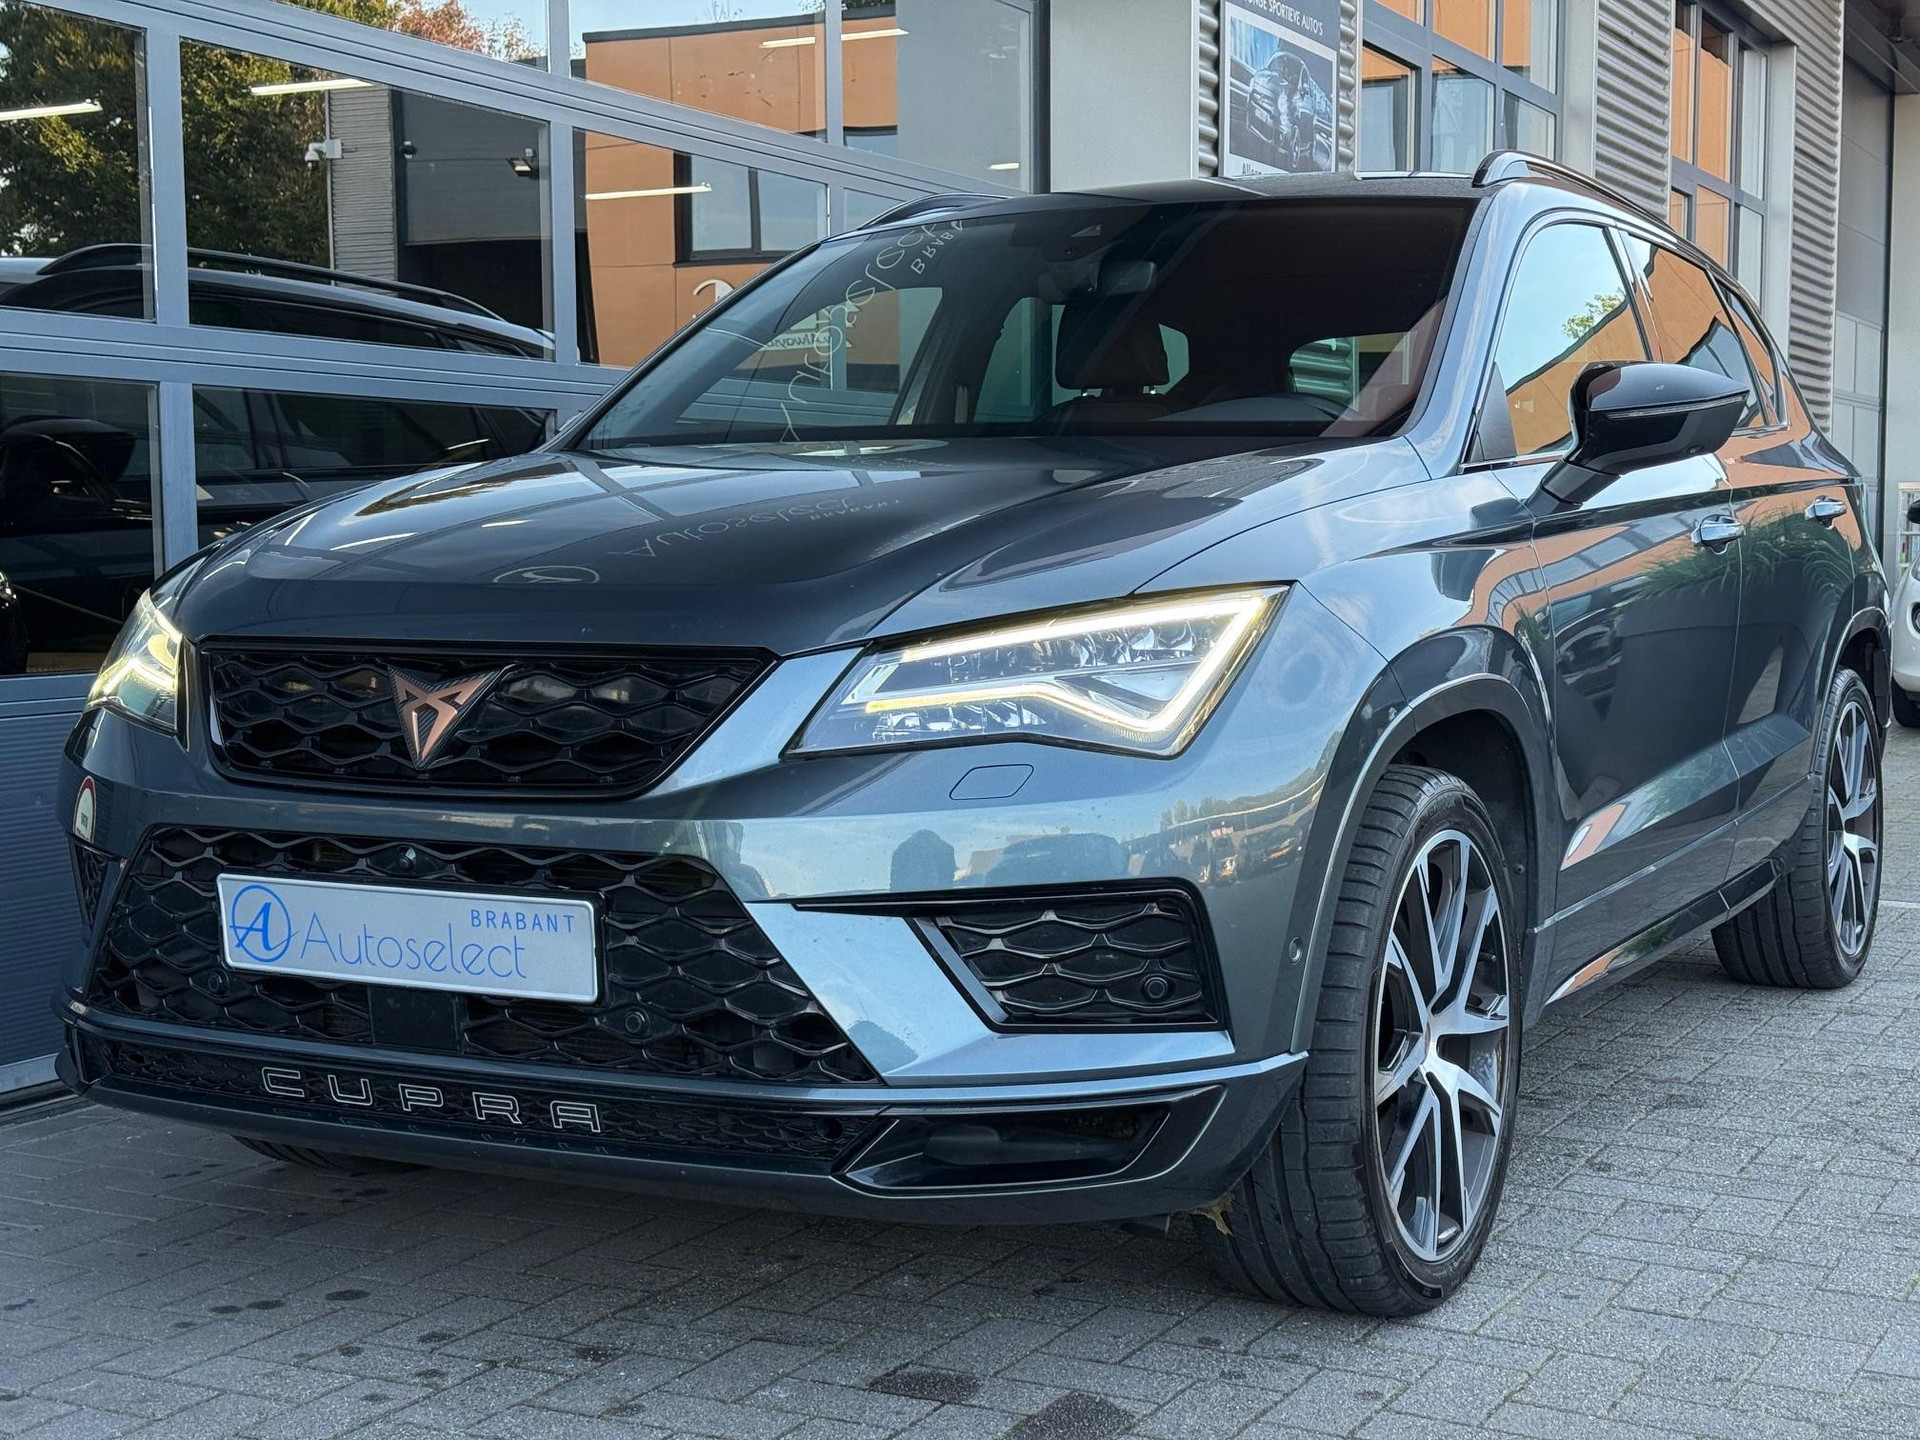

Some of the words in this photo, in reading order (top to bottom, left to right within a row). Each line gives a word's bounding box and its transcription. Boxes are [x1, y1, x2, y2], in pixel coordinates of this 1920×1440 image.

[1269, 0, 1301, 26] SPORTIEVE
[1301, 14, 1324, 36] AUTO'S
[300, 912, 527, 979] Autoselect
[471, 909, 575, 934] BRABANT
[261, 1066, 601, 1133] CUPRA
